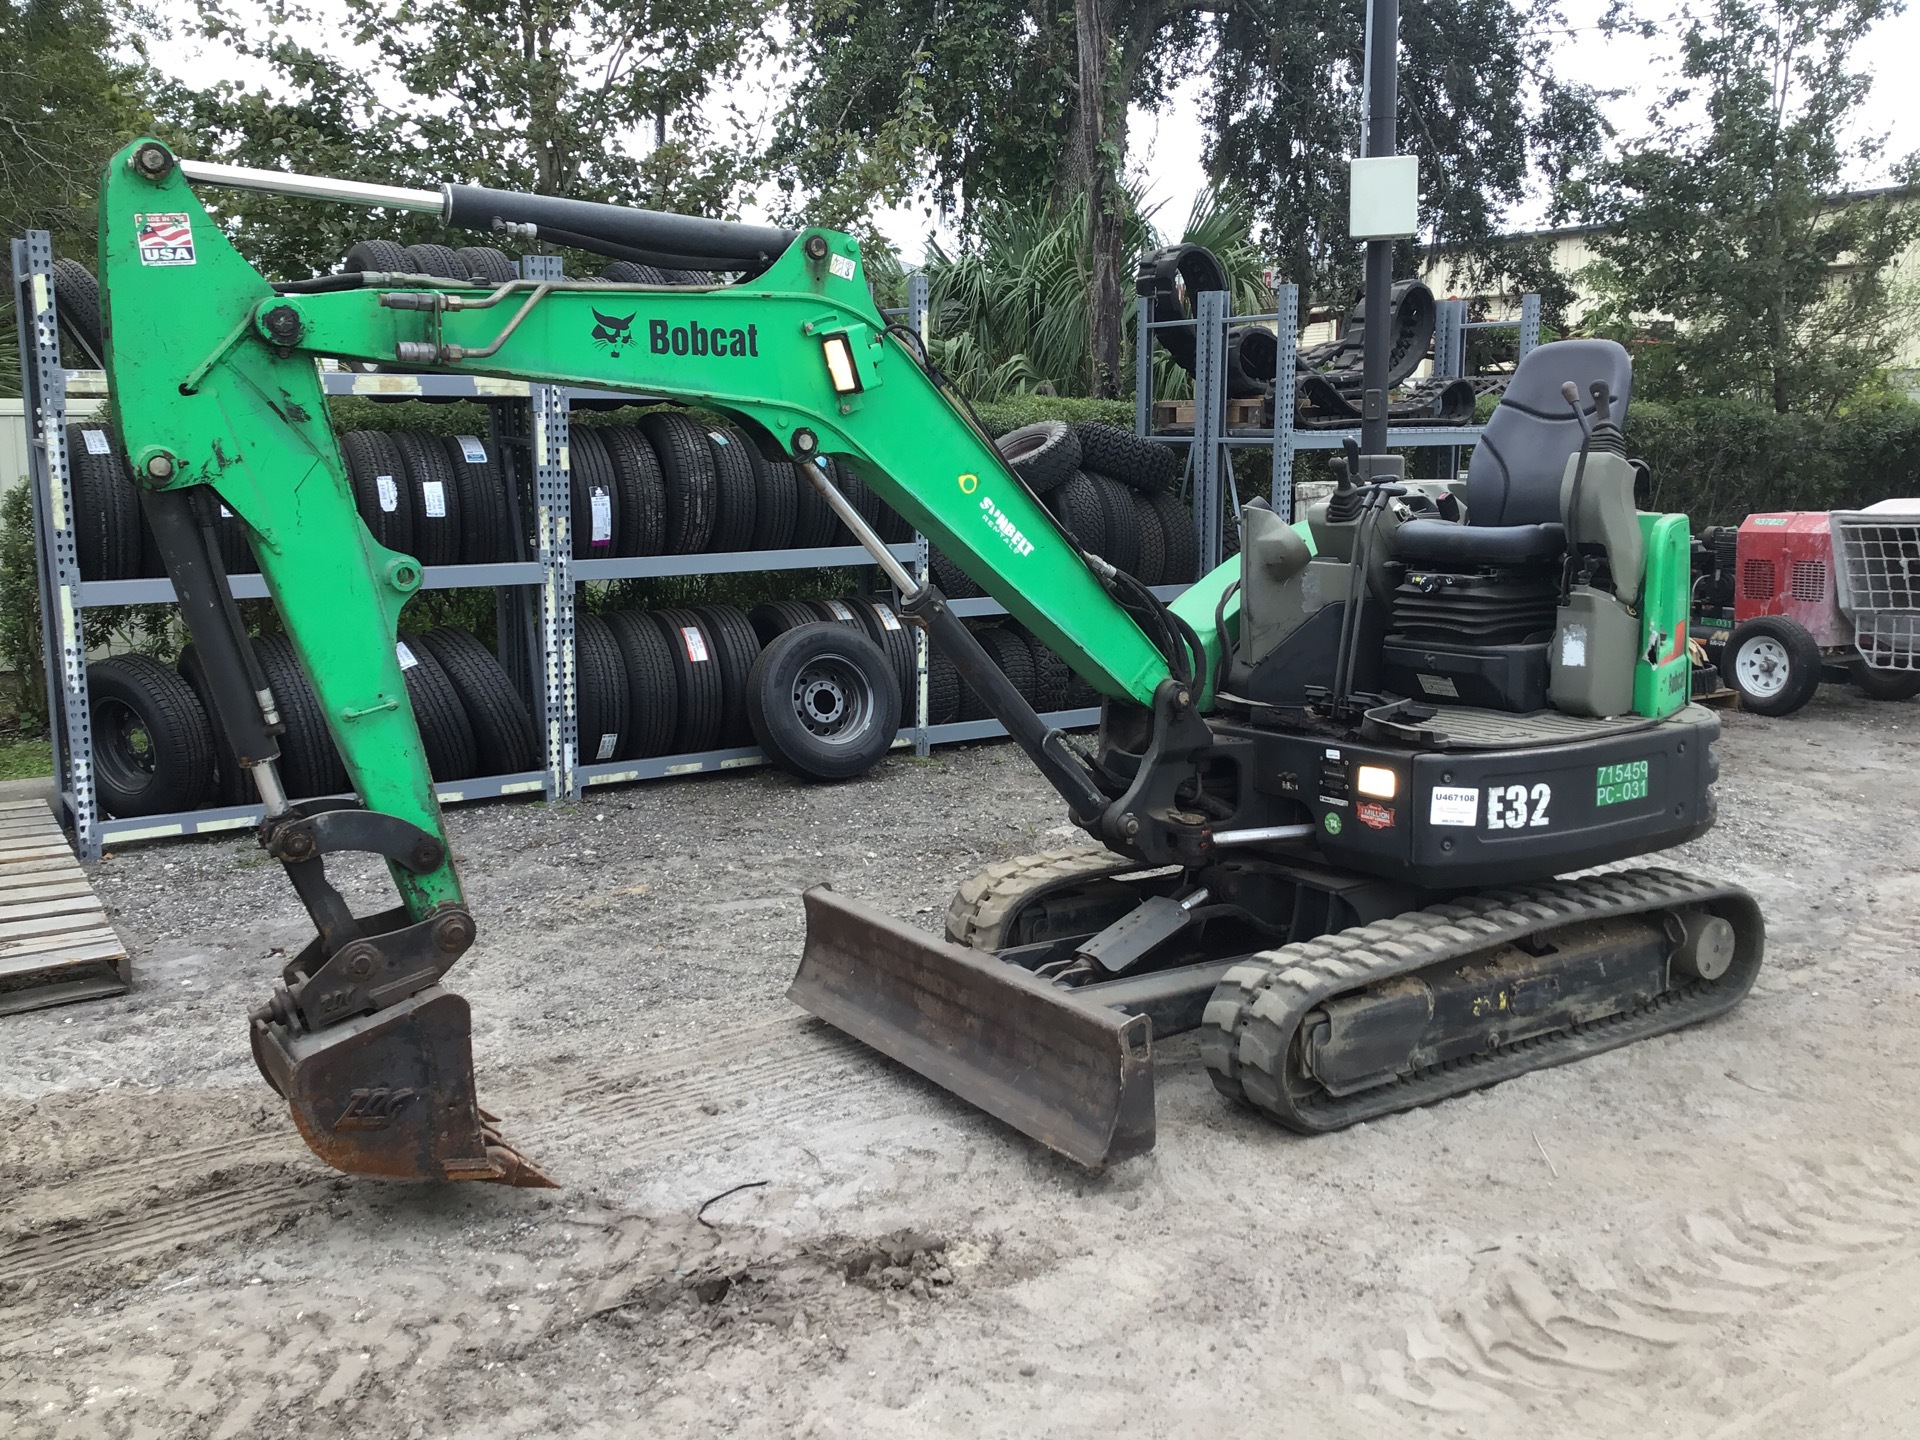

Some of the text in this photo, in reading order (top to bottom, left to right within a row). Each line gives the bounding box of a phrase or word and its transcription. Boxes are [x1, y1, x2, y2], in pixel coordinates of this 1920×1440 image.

[143, 248, 191, 260] USA
[648, 319, 759, 357] Bobcat
[979, 496, 1035, 557] SUNBELT
[982, 514, 1020, 554] RENTALS
[1598, 760, 1648, 785] 715459
[1435, 793, 1475, 803] U467108
[1487, 783, 1551, 829] E32
[1596, 779, 1646, 807] PC-031
[1364, 808, 1389, 820] MILLION
